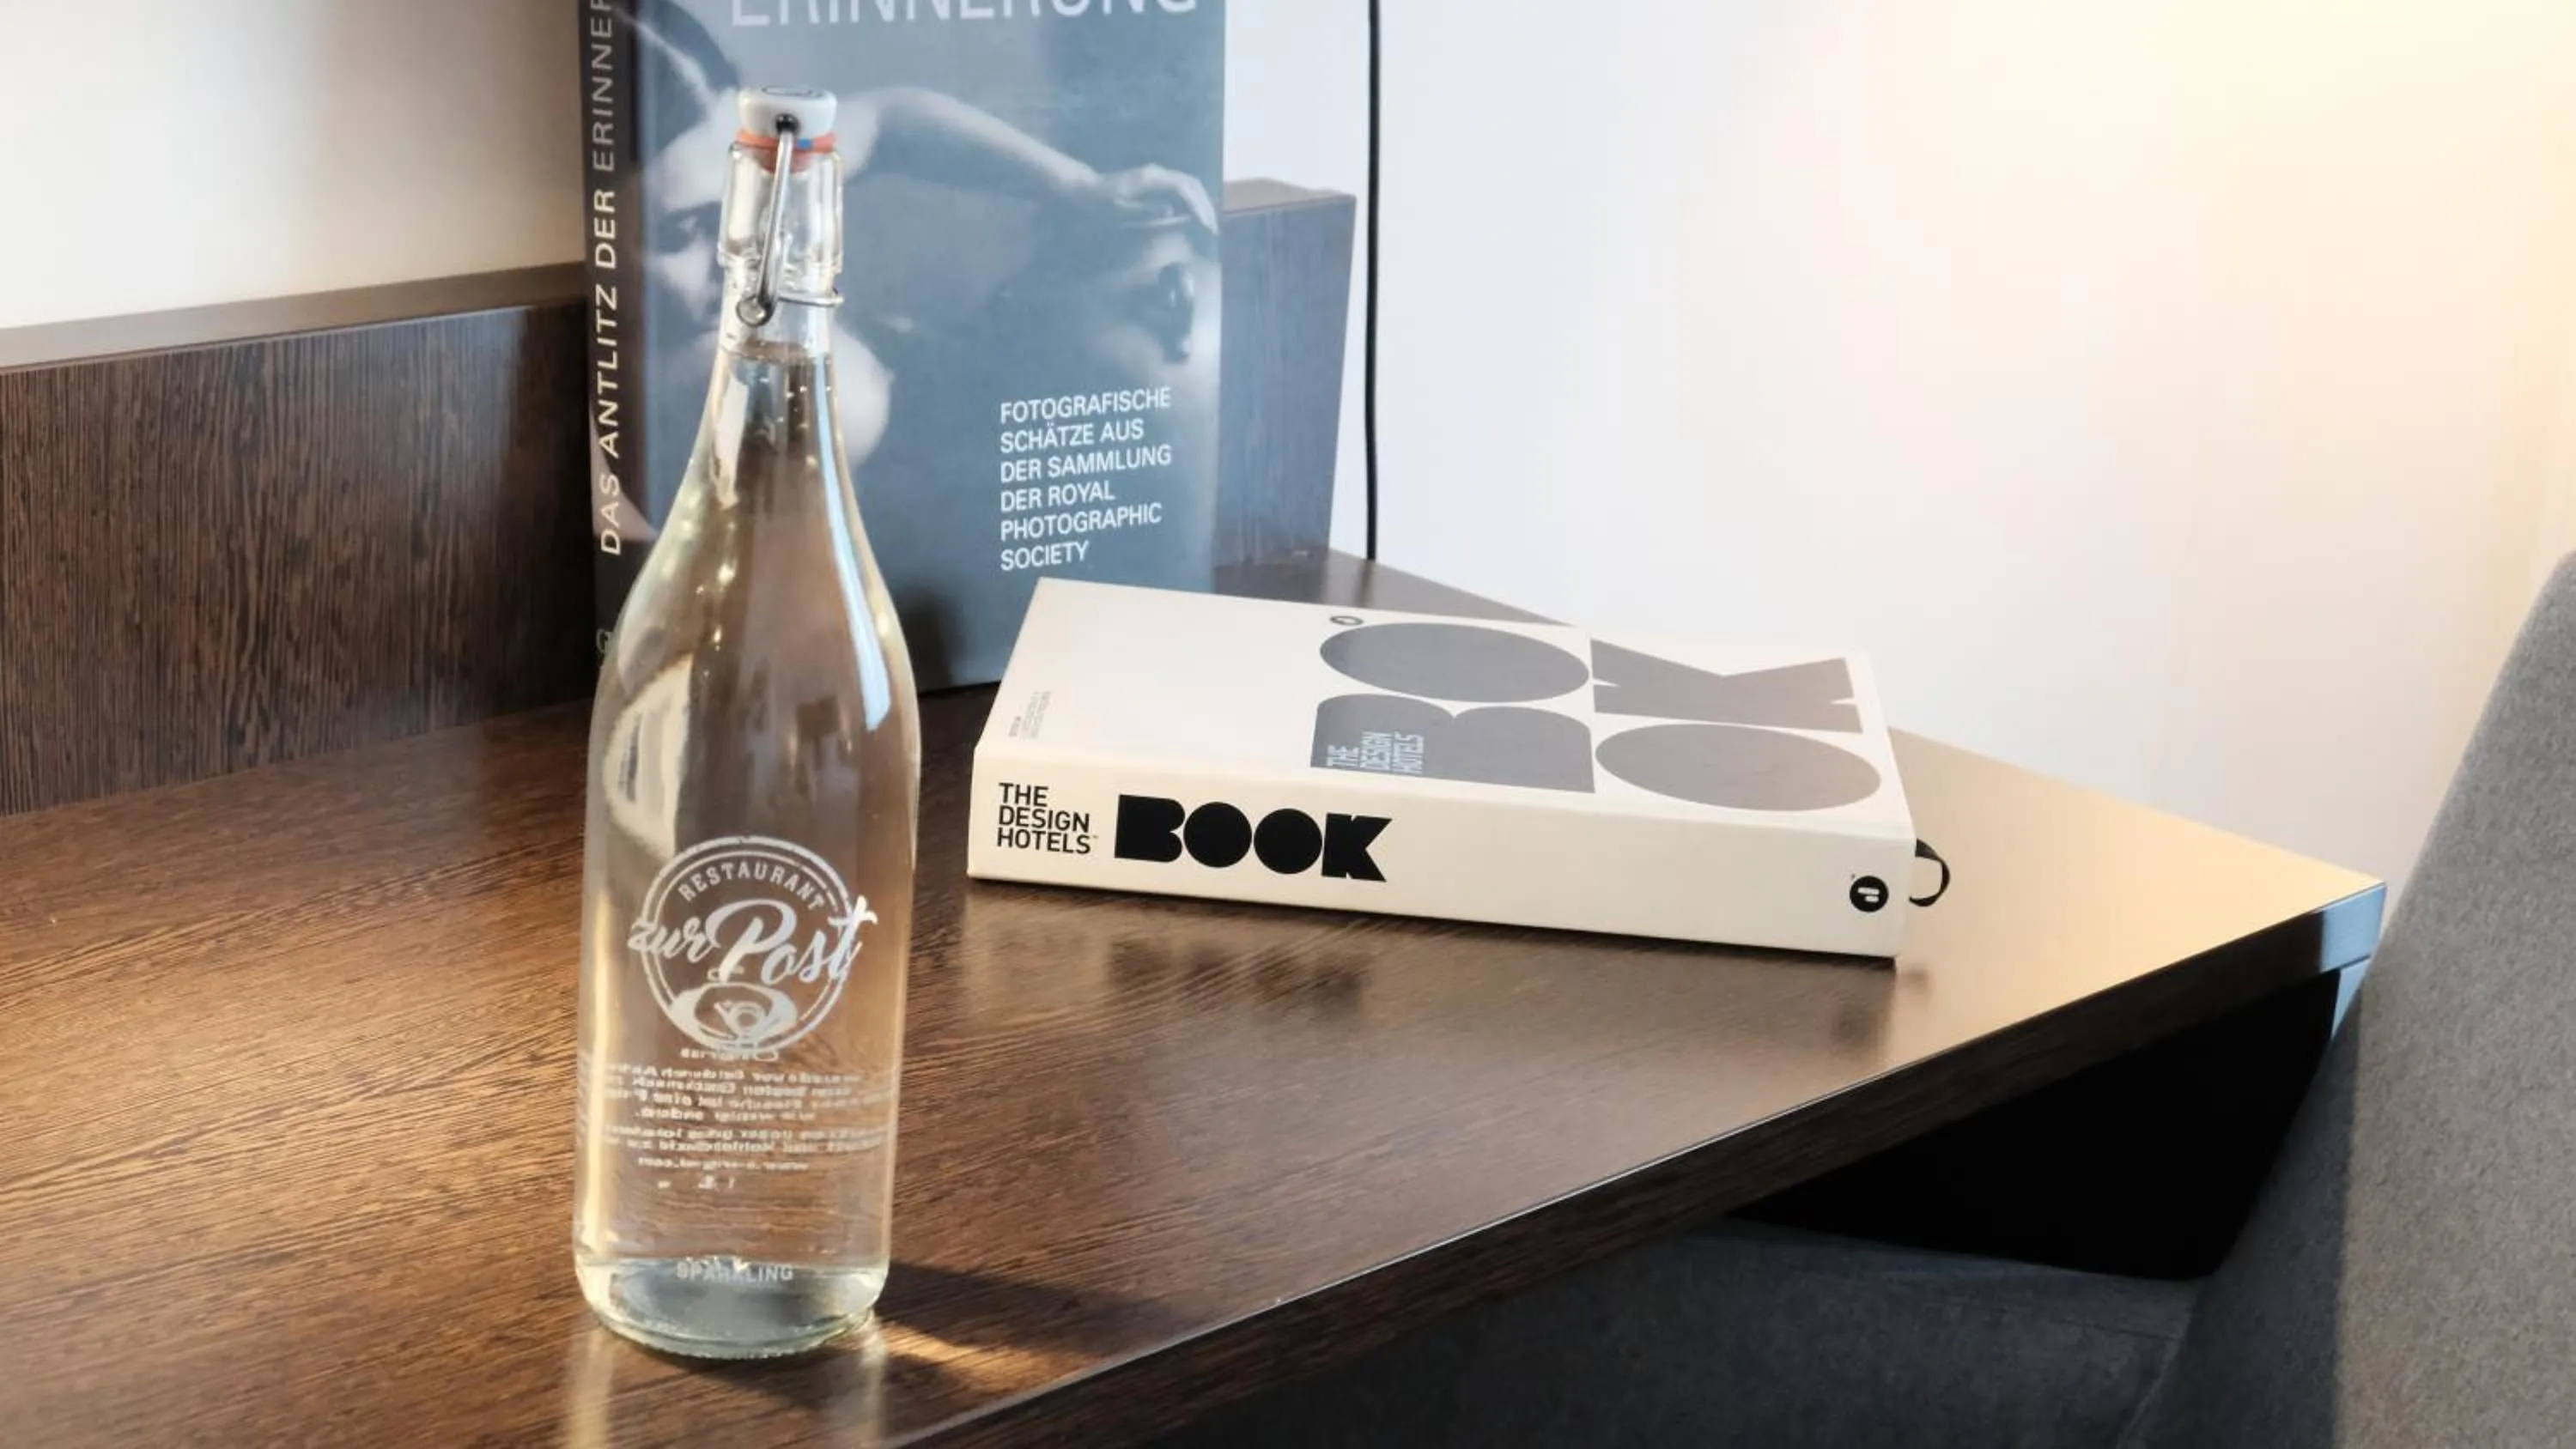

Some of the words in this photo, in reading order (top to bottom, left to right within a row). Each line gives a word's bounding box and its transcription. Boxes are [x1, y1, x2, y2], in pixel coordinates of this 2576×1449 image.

[593, 189, 616, 269] DER
[595, 283, 619, 458] ANTLITZ
[1000, 387, 1171, 424] FOTOGRAFISCHE
[1000, 421, 1095, 453] SCHÄTZE
[1099, 418, 1144, 443] AUS
[1000, 458, 1042, 483] DER
[1047, 444, 1171, 477] SAMMLUNG
[601, 474, 621, 555] DAS
[1000, 488, 1042, 512] DER
[1048, 480, 1115, 506] ROYAL
[1000, 502, 1162, 542] PHOTOGRAPHIC
[1000, 539, 1089, 571] SOCIETY
[1327, 745, 1359, 767] THE
[1359, 731, 1393, 771] DESIGN
[1392, 731, 1425, 774] HOTELS
[999, 782, 1049, 807] THE
[999, 805, 1090, 833] DESIGN
[1115, 794, 1393, 882] BOOK
[677, 861, 825, 910] RESTAURANT
[705, 899, 878, 985] Post
